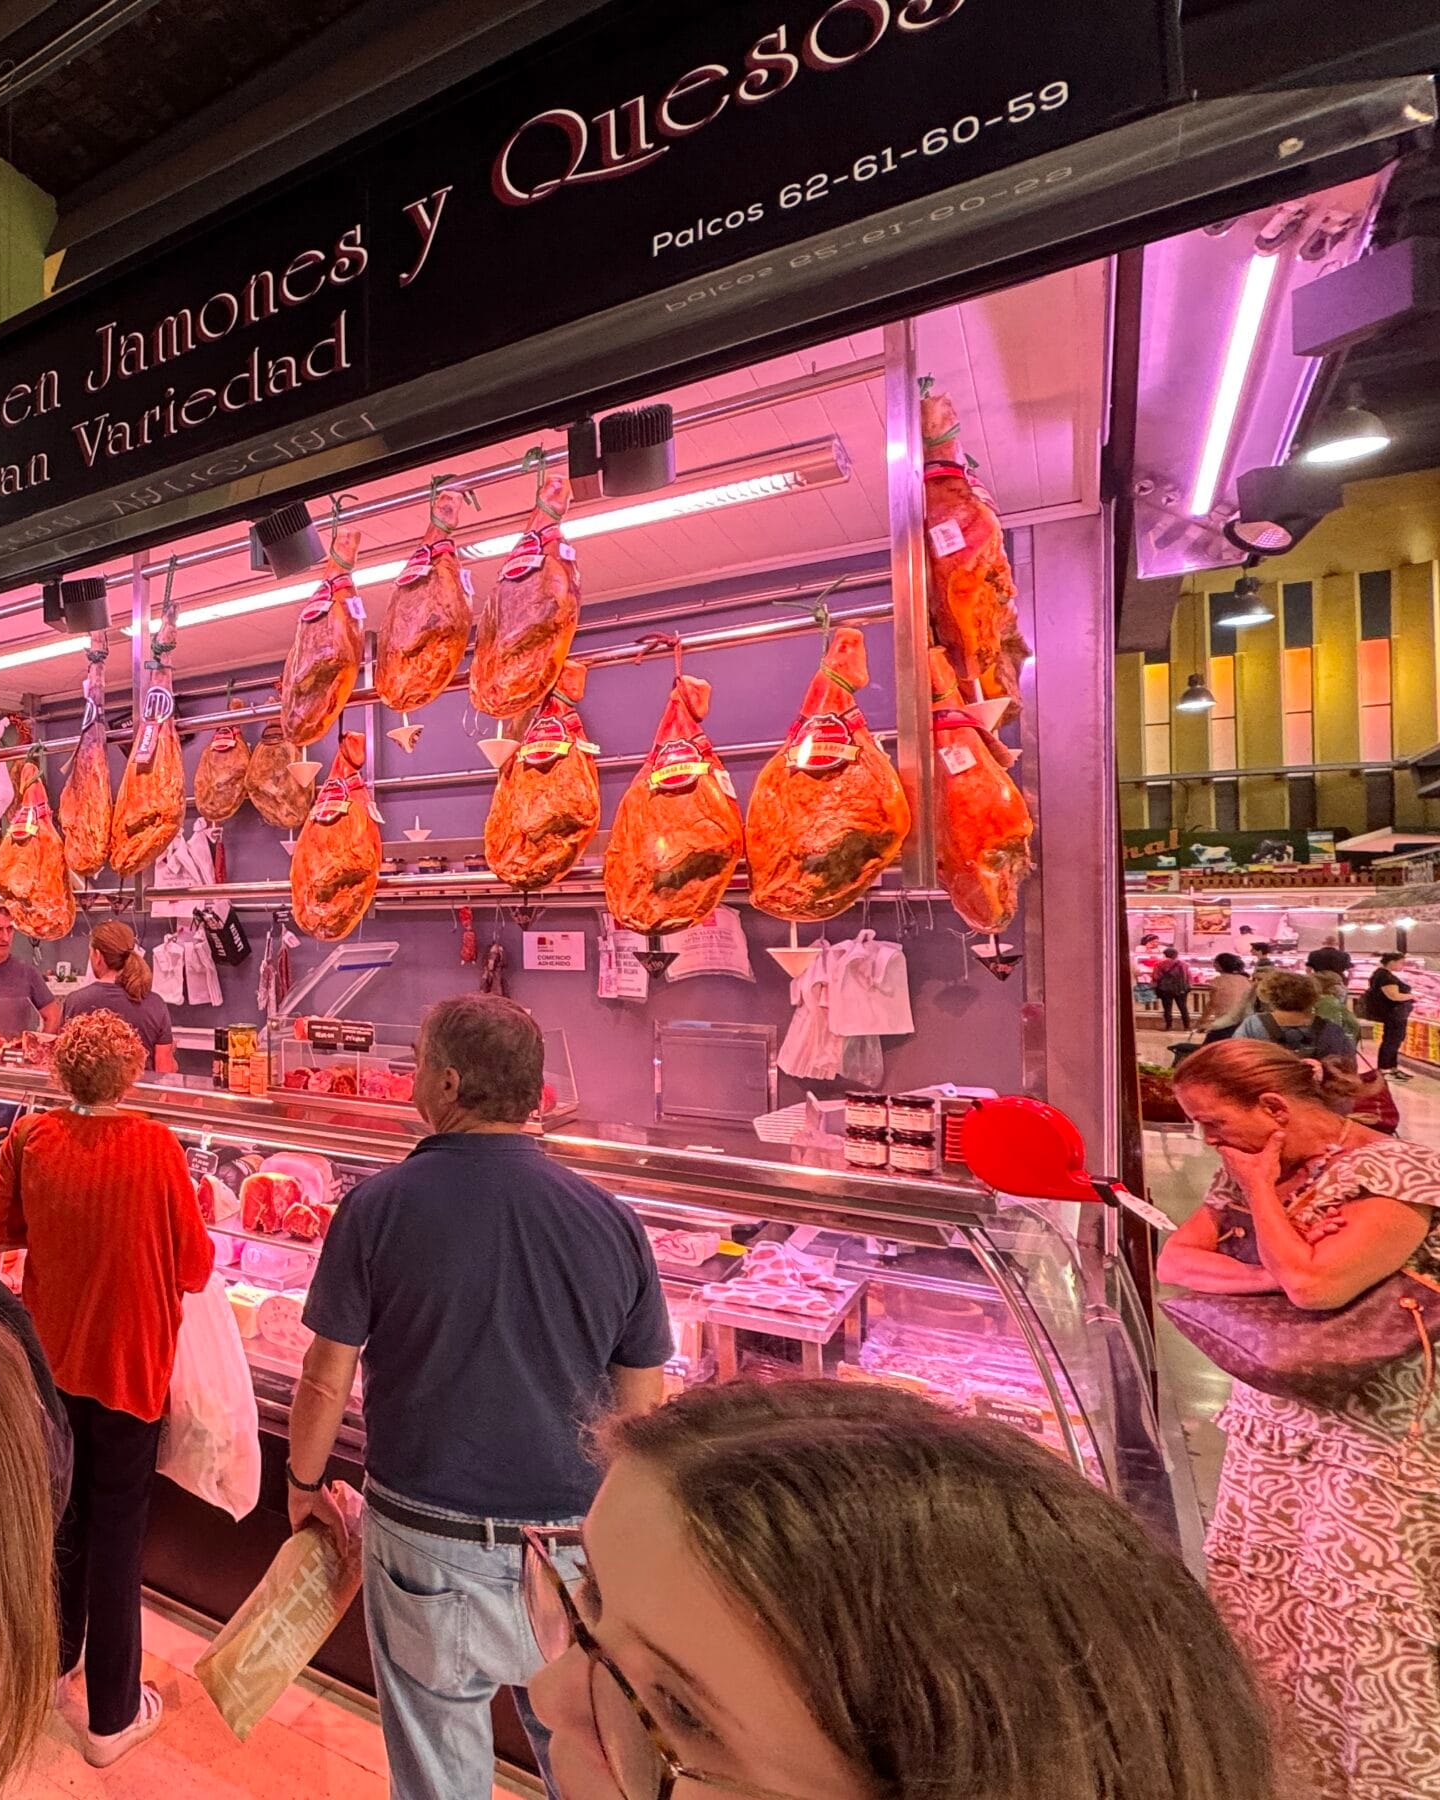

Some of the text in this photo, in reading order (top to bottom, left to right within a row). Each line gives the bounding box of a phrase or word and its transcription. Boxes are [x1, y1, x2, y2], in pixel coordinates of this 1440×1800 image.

[652, 81, 1070, 257] Palcos 62-61-60-59
[0, 366, 60, 428] en
[85, 223, 368, 394] Jamones
[399, 185, 453, 288] y
[72, 309, 351, 469] Variedad
